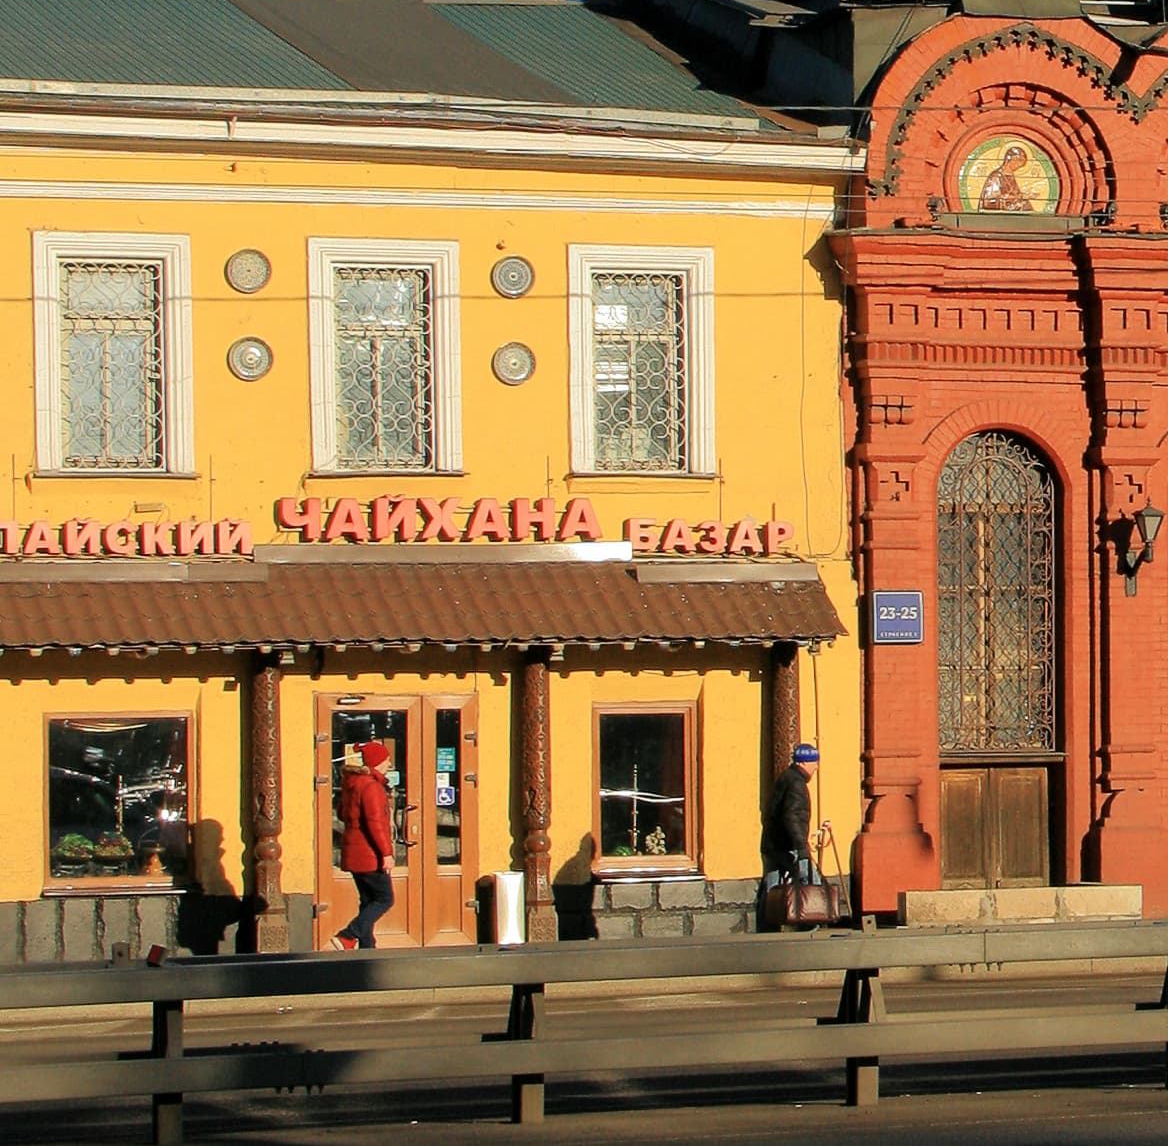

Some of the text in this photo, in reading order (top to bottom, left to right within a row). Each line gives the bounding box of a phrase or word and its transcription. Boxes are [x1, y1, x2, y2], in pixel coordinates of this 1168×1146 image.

[278, 494, 604, 540] ЧАЙХАНА
[627, 517, 795, 554] БАЗАР
[879, 606, 918, 620] 23-25
